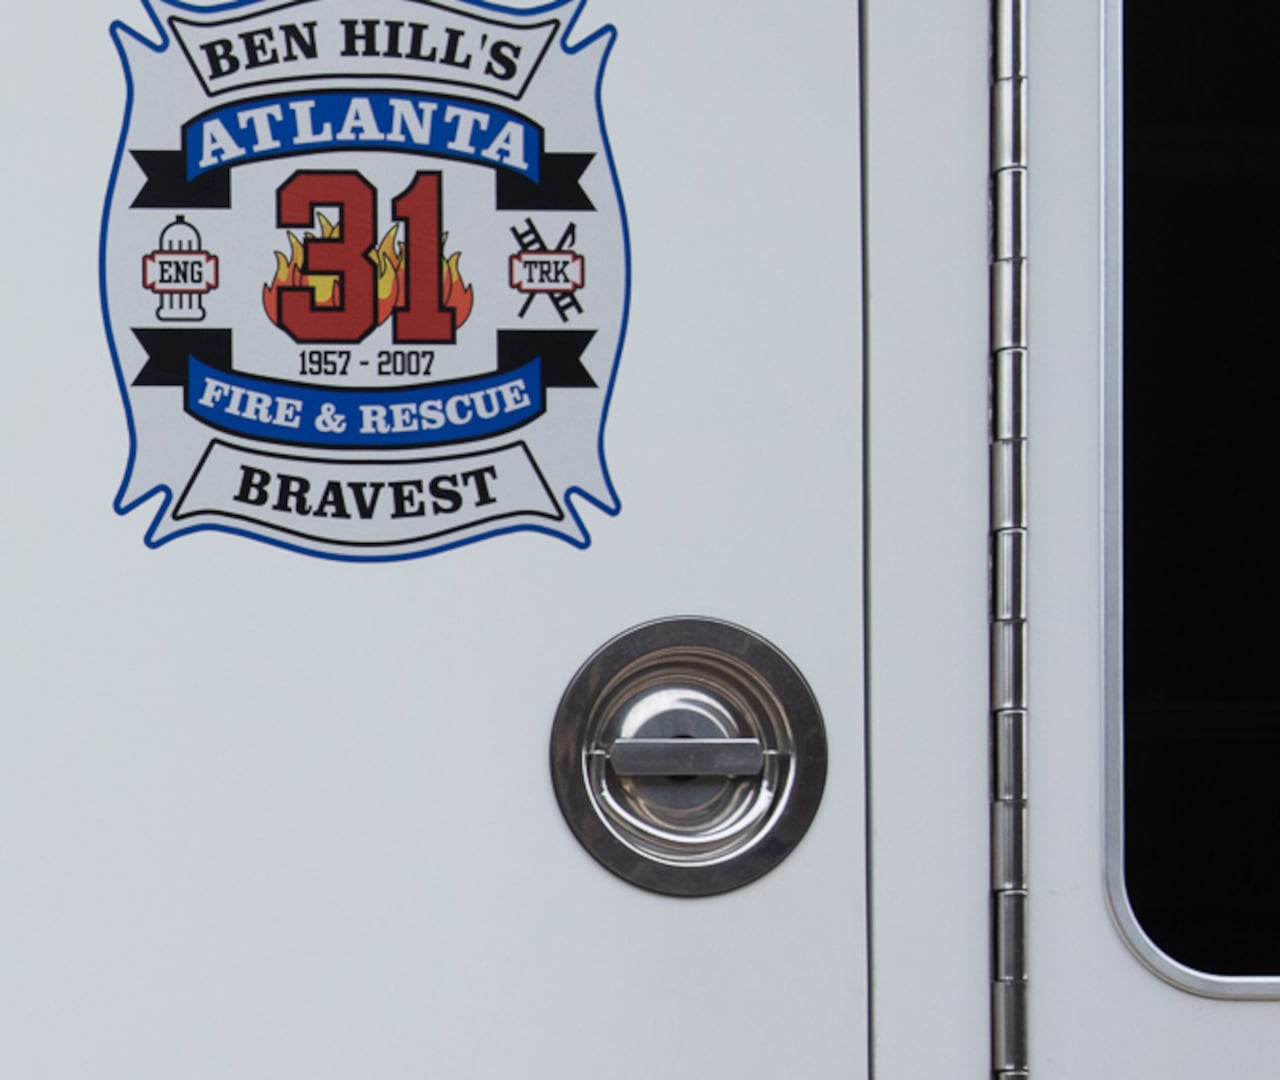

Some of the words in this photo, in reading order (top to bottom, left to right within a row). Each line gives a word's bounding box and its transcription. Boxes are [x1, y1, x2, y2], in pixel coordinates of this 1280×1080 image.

[200, 21, 318, 81] BEN
[340, 19, 522, 81] HILL'S
[198, 97, 529, 171] ATLANTA
[159, 261, 203, 284] ENG
[276, 169, 457, 345] 31
[522, 261, 570, 284] TRK
[298, 350, 351, 376] 1957
[377, 350, 435, 376] 2007
[198, 377, 302, 429] FIRE
[314, 403, 347, 434] &
[359, 379, 531, 434] RESCUE
[232, 465, 498, 519] BRAVEST
